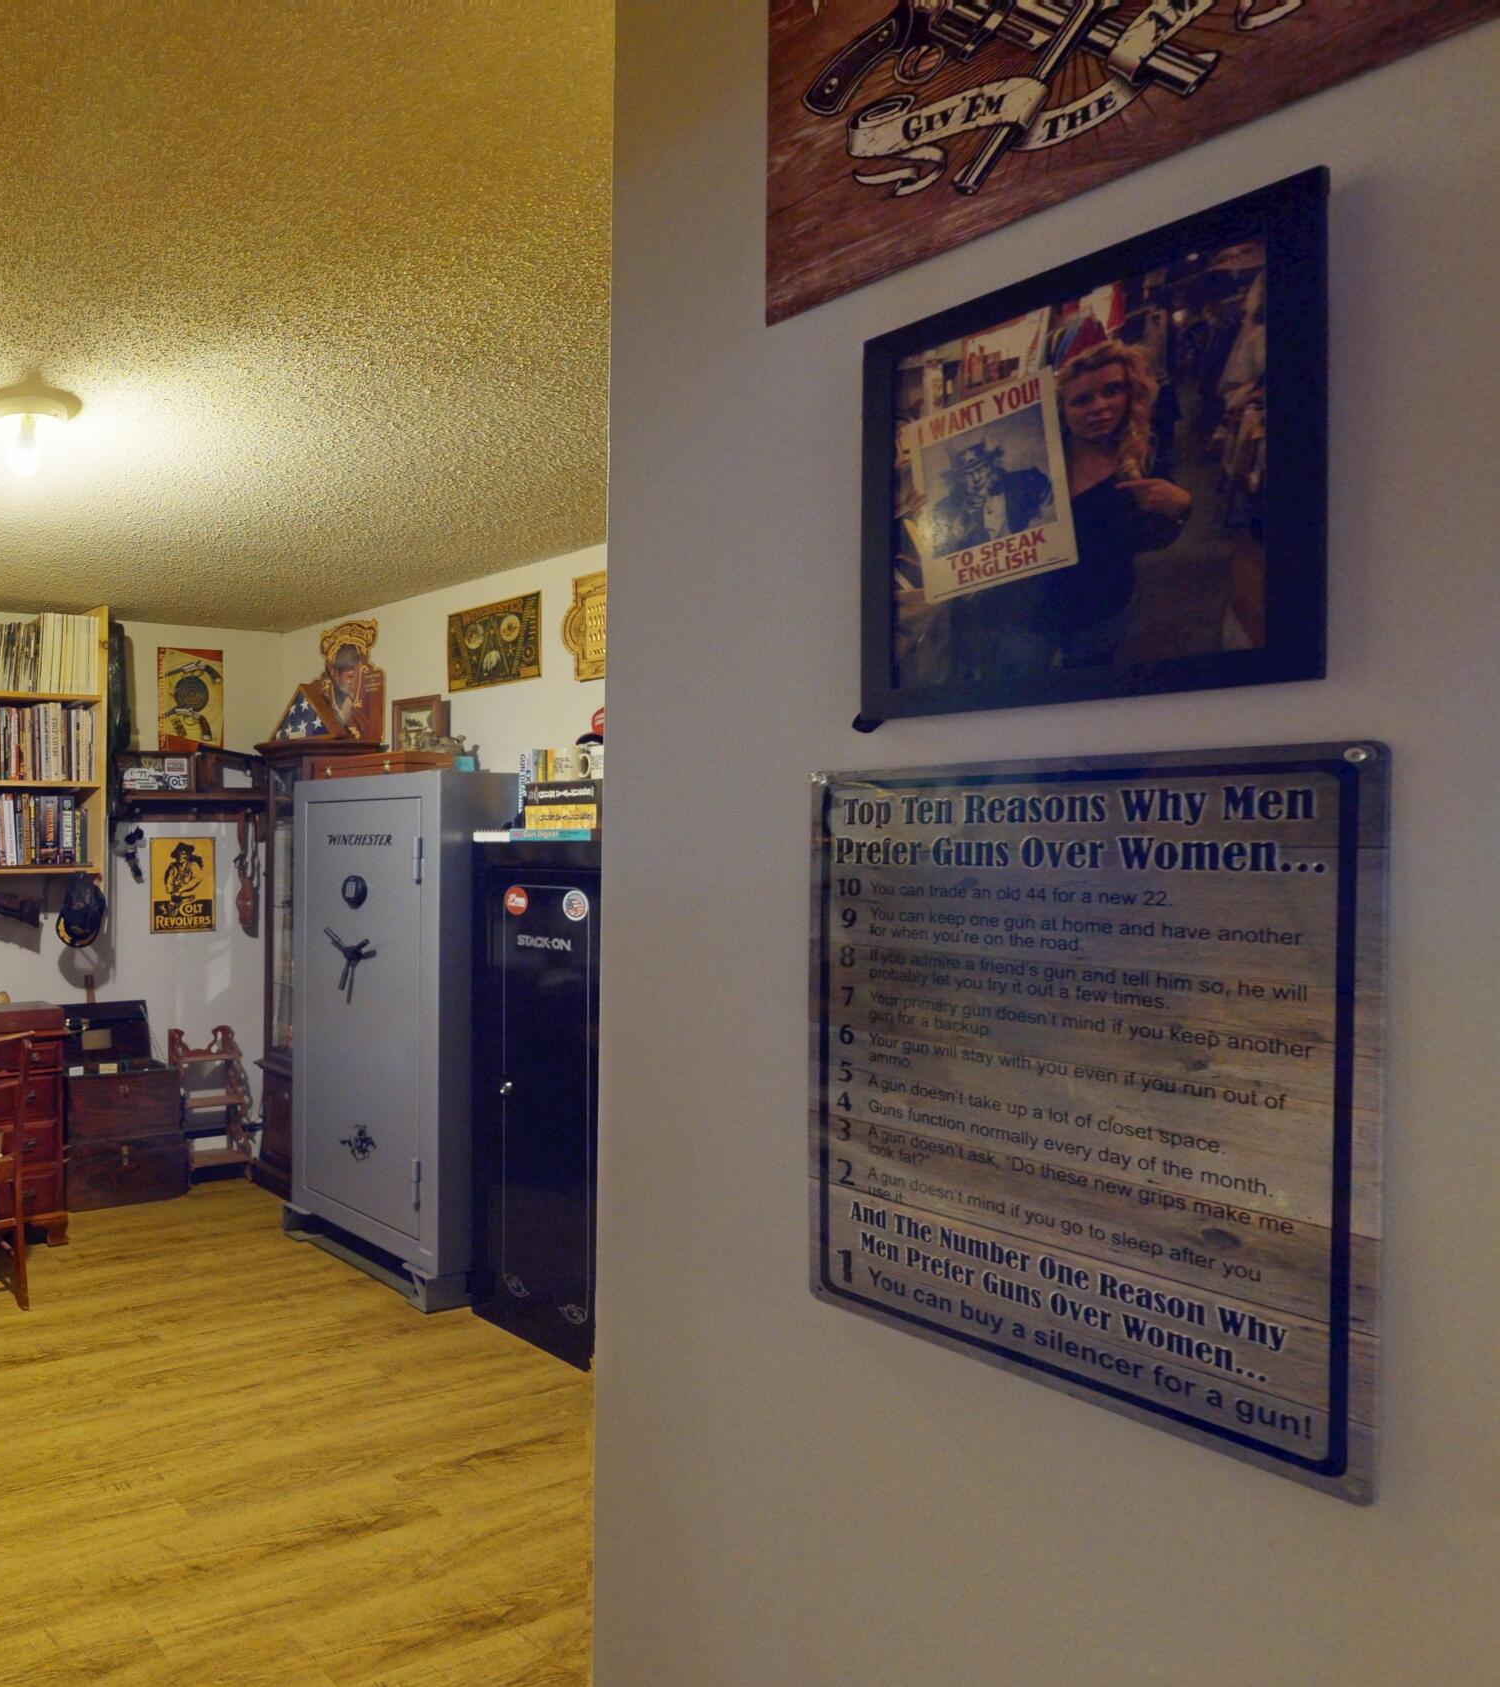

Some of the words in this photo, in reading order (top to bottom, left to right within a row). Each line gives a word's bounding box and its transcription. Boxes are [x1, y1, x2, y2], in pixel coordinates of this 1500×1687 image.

[902, 104, 953, 141] GIV
[1041, 91, 1116, 142] THE
[917, 424, 924, 445] I
[929, 400, 984, 440] WANT
[993, 377, 1041, 415] YOU!
[946, 551, 973, 570] TO
[979, 528, 1045, 562] SPEAK
[958, 548, 1038, 584] ENGLISH
[844, 797, 892, 829] Top
[901, 795, 953, 825] Ten
[963, 793, 1105, 822] Reasons
[1119, 788, 1208, 826] Why
[1222, 785, 1315, 821] Men
[326, 833, 393, 848] WINCHESTER
[836, 836, 922, 865] Prefer
[932, 837, 1009, 867] Guns
[1021, 836, 1105, 870] Over
[1118, 836, 1326, 873] Women...
[180, 900, 203, 917] COLT
[838, 878, 862, 897] 10
[870, 881, 895, 896] You
[900, 885, 925, 896] can
[930, 885, 967, 898] trade
[972, 888, 991, 899] an
[996, 885, 1021, 900] old
[1026, 888, 1046, 901] 44
[1053, 887, 1076, 903] for
[1081, 892, 1092, 904] a
[1098, 893, 1137, 905] new
[1143, 890, 1172, 907] 22.
[156, 915, 211, 930] REVOLVERS
[841, 908, 858, 928] 9
[870, 906, 895, 921] You
[900, 911, 925, 923] can
[930, 910, 965, 927] keep
[970, 915, 1000, 927] one
[1004, 917, 1035, 931] gun
[1041, 918, 1057, 930] at
[1062, 916, 1112, 937] home
[1119, 923, 1155, 937] and
[1161, 924, 1211, 941] have
[1217, 928, 1304, 945] another
[870, 923, 887, 937] for
[892, 926, 928, 940] when
[933, 929, 979, 945] you're
[984, 934, 1003, 945] on
[1010, 933, 1035, 948] the
[1040, 934, 1083, 951] road.
[839, 946, 856, 967] 8
[870, 949, 879, 961] If
[881, 952, 907, 966] you
[910, 952, 961, 969] admire
[966, 960, 975, 970] a
[980, 958, 1038, 976] friend's
[1043, 965, 1075, 980] gun
[1083, 969, 1115, 984] and
[1122, 972, 1149, 987] tell
[1156, 973, 1192, 991] him
[1198, 981, 1232, 996] so,
[1238, 980, 1264, 998] he
[1272, 983, 1308, 1002] will
[838, 1025, 855, 1045] 6
[869, 1032, 899, 1049] Your
[903, 1040, 930, 1055] gun
[934, 1040, 957, 1058] will
[962, 1048, 994, 1067] stay
[998, 1051, 1032, 1070] with
[1036, 1058, 1068, 1076] you
[1074, 1067, 1117, 1085] even
[1124, 1071, 1135, 1086] if
[1140, 1076, 1176, 1093] you
[1183, 1082, 1216, 1099] run
[1222, 1086, 1257, 1106] out
[1264, 1094, 1287, 1110] of
[868, 1051, 913, 1070] ammo.
[838, 1060, 853, 1083] 5
[868, 1074, 878, 1088] A
[881, 1078, 906, 1093] gun
[910, 1081, 965, 1105] doesn't
[969, 1095, 1001, 1112] take
[1006, 1102, 1028, 1119] up
[1032, 1106, 1043, 1119] a
[1050, 1107, 1069, 1124] lot
[1074, 1113, 1093, 1129] of
[1097, 1115, 1153, 1141] closet
[1160, 1129, 1226, 1155] space.
[836, 1091, 853, 1112] 4
[868, 1099, 904, 1119] Guns
[908, 1106, 965, 1132] function
[970, 1122, 1039, 1150] normally
[1043, 1136, 1092, 1161] every
[1098, 1148, 1132, 1171] day
[1137, 1156, 1156, 1172] of
[1162, 1159, 1193, 1180] the
[1201, 1170, 1274, 1198] month.
[850, 1201, 887, 1230] And
[893, 1213, 932, 1244] The
[939, 1226, 1031, 1273] Number
[1039, 1256, 1090, 1291] One
[1100, 1272, 1205, 1326] Reason
[1217, 1305, 1288, 1352] Why
[861, 1231, 899, 1263] Men
[906, 1246, 975, 1287] Prefer
[983, 1271, 1042, 1309] Guns
[1051, 1292, 1112, 1331] Over
[1122, 1312, 1267, 1383] Women...
[836, 1250, 853, 1284] 1
[868, 1266, 906, 1297] You
[912, 1287, 952, 1313] can
[960, 1299, 1004, 1334] buy
[1012, 1322, 1026, 1339] a
[1033, 1326, 1145, 1380] silencer
[1153, 1364, 1197, 1398] for
[1206, 1388, 1224, 1408] a
[1235, 1398, 1312, 1440] gun!
